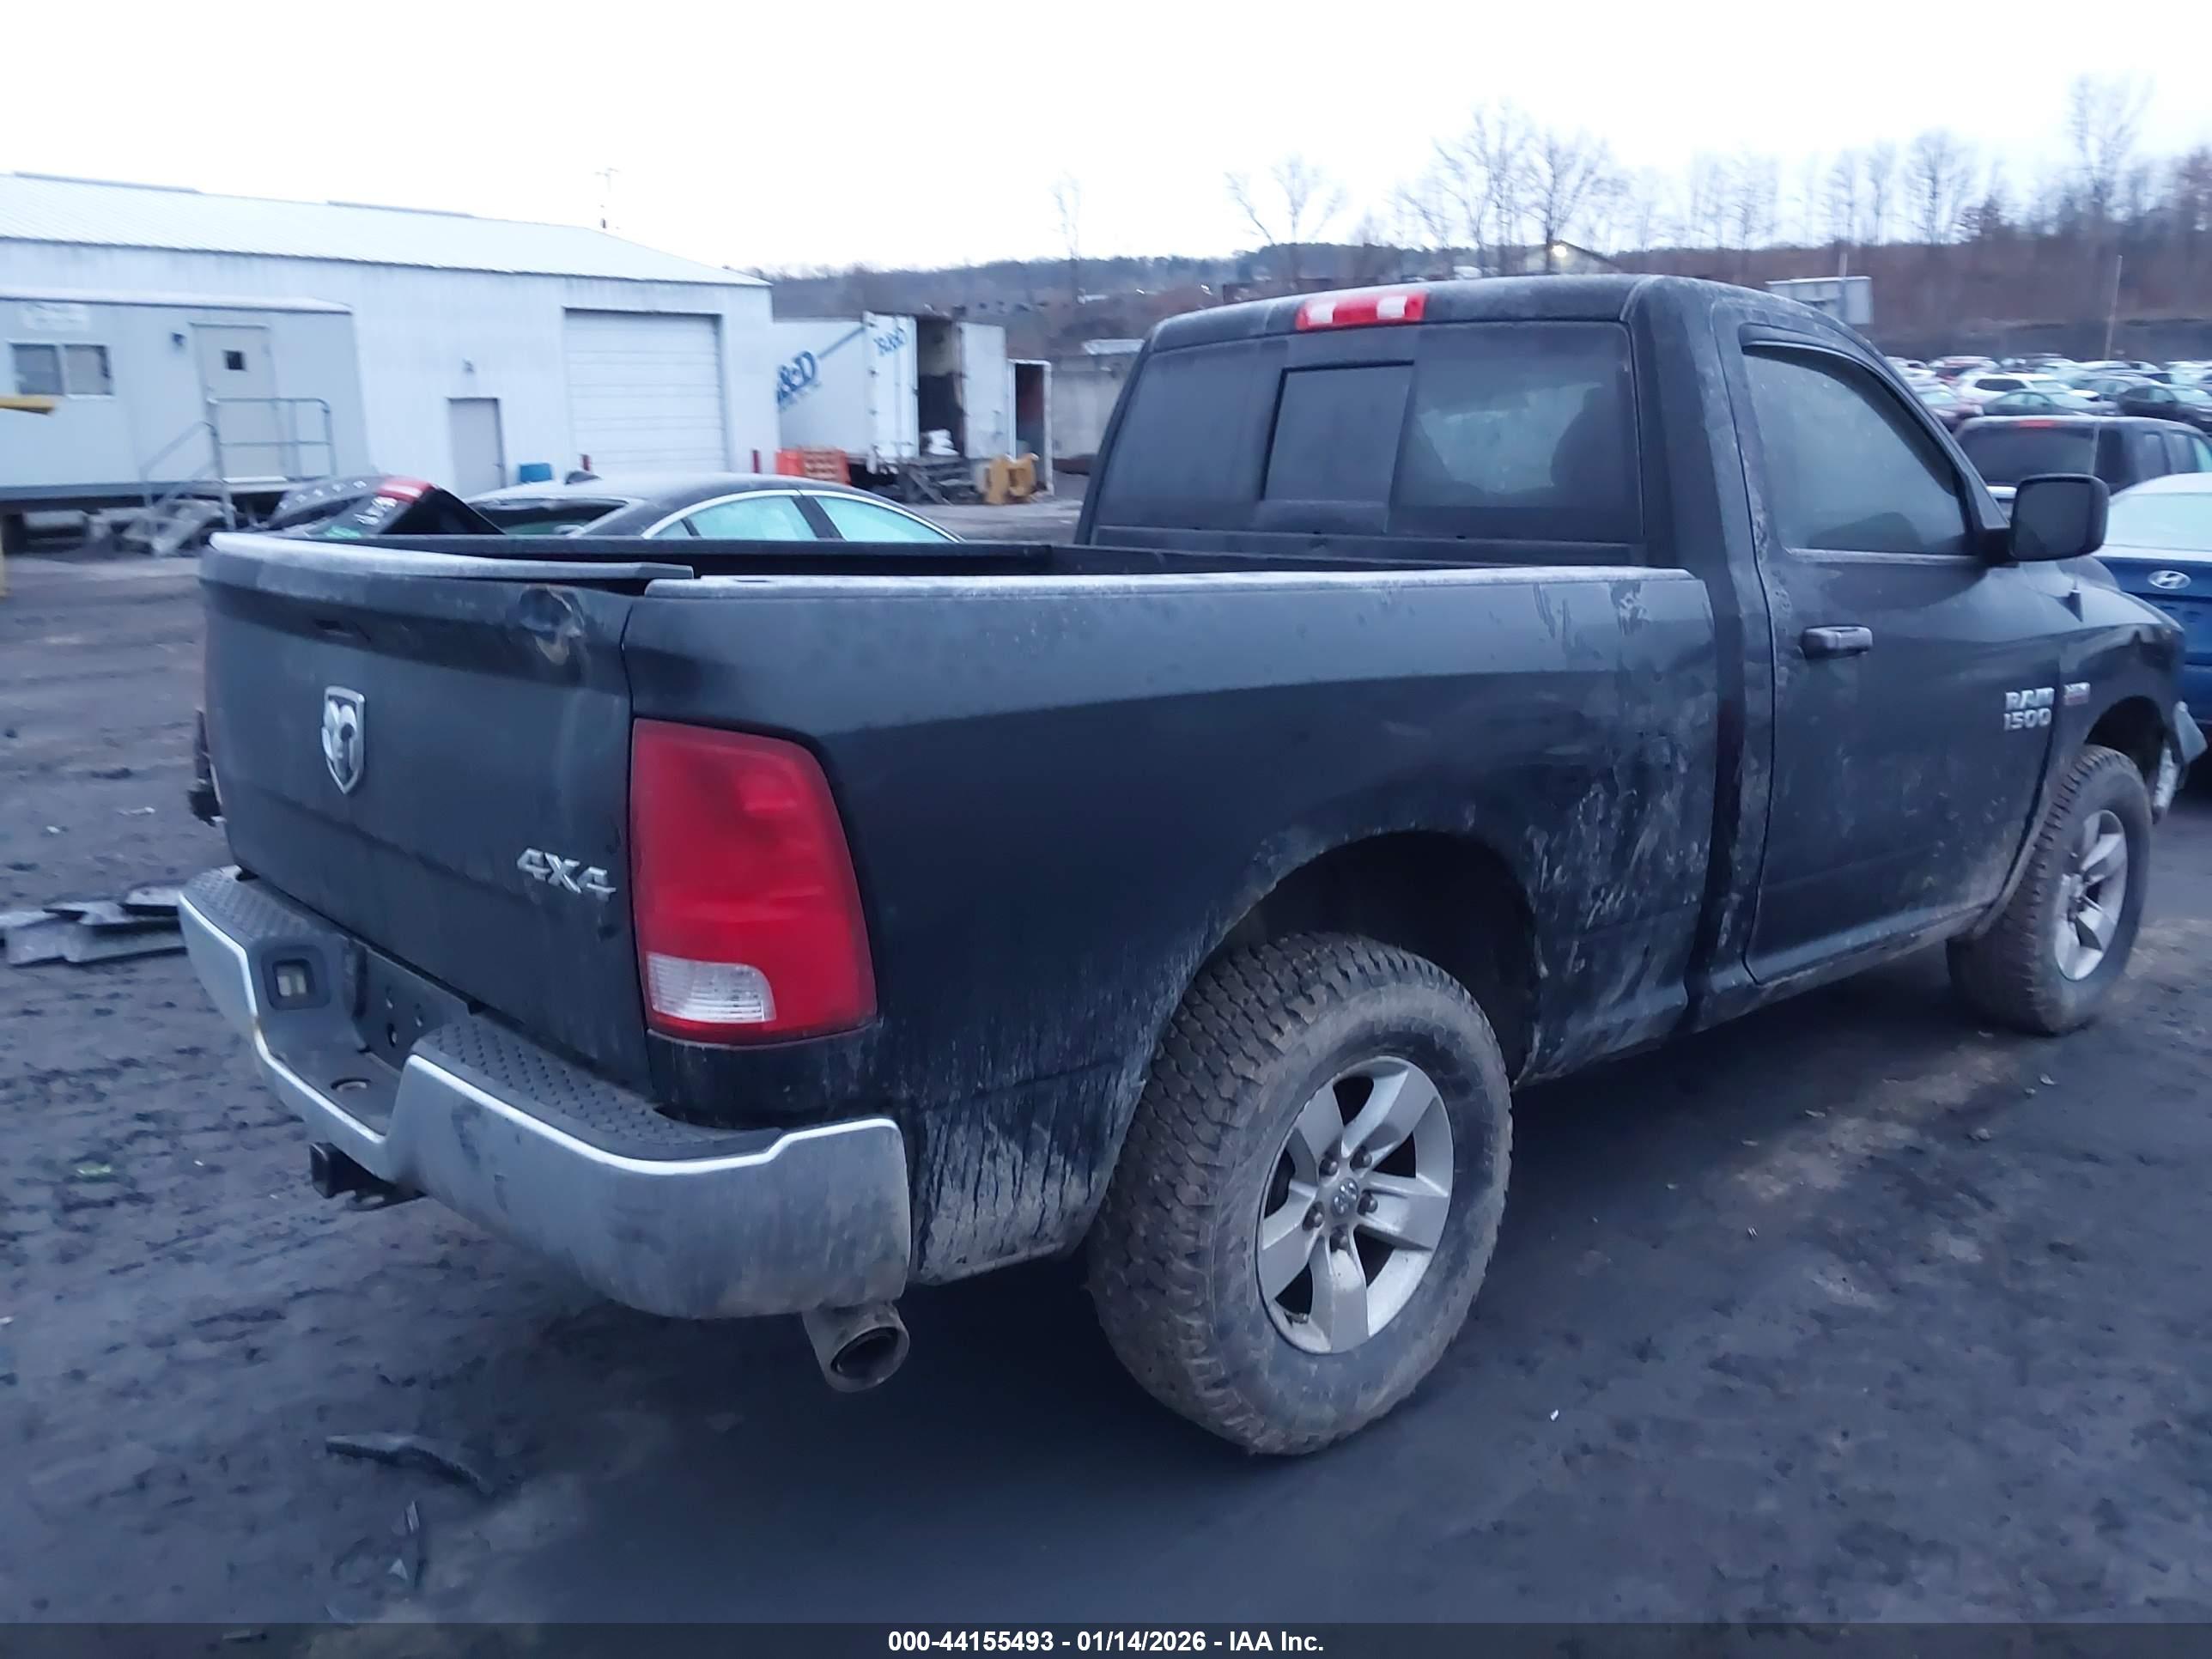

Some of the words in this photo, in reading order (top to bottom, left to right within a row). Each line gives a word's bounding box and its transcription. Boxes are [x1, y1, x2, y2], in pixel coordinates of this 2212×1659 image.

[2005, 687, 2055, 711] RAM
[2003, 708, 2052, 731] 1500
[517, 848, 617, 902] 4X4
